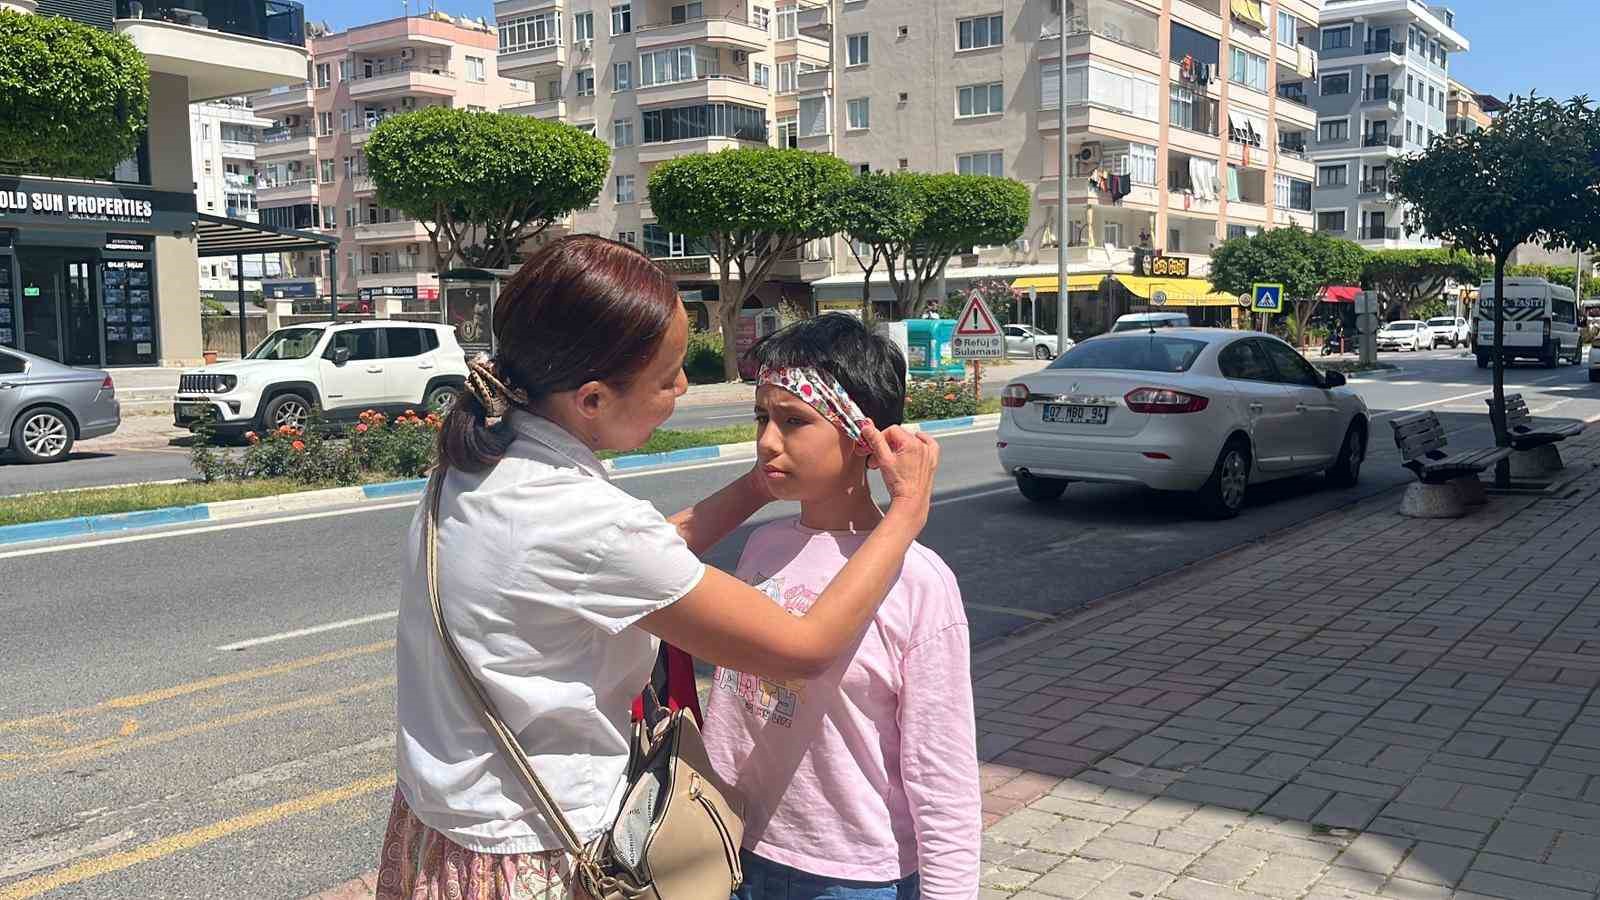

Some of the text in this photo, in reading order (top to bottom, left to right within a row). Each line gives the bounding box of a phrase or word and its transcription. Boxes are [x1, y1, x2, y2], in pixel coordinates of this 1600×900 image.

[31, 193, 63, 211] SUN
[67, 195, 152, 217] PROPERTIES
[1049, 406, 1061, 417] 07
[1091, 408, 1104, 419] 94
